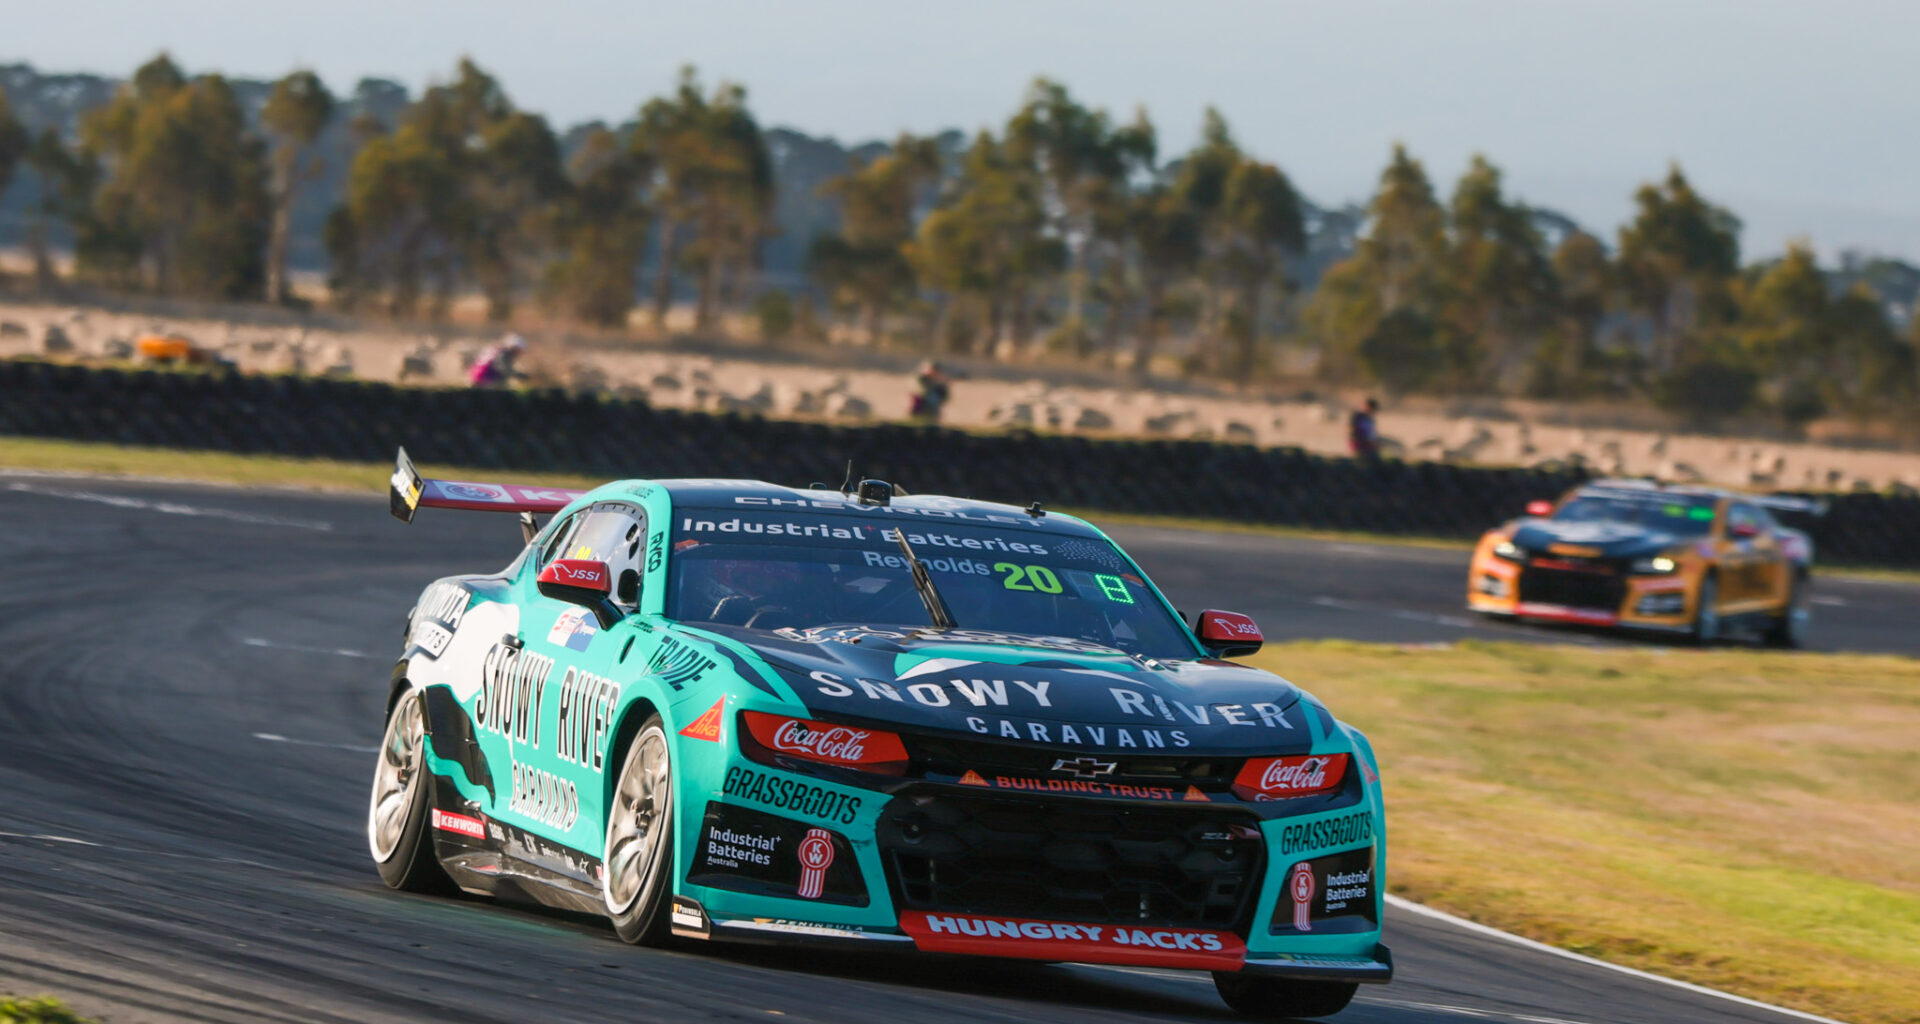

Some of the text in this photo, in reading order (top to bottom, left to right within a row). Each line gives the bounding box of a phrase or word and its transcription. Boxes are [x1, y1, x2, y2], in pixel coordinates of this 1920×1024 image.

[735, 497, 1046, 527] CHEVROLET
[647, 530, 664, 573] RYCO
[880, 527, 1049, 555] Batteries
[568, 568, 600, 582] JSSI
[993, 562, 1063, 594] 20
[475, 642, 555, 749] SNOWY
[809, 670, 1294, 730] SNOWY RIVER
[685, 708, 720, 736] Sika
[966, 716, 1191, 748] CARAVANS
[773, 719, 871, 761] Coca-Cola
[508, 759, 579, 833] CARAVANS
[722, 766, 862, 825] GRASSBOOTS
[996, 776, 1103, 794] BUILDING
[1104, 784, 1174, 800] TRUST
[440, 814, 485, 837] KENWORTH
[1281, 810, 1374, 856] GRASSBOOTS
[706, 855, 739, 869] Australia
[707, 840, 771, 866] Batteries
[1325, 885, 1367, 902] Batteries
[926, 914, 1223, 951] HUNGRY JACK'S
